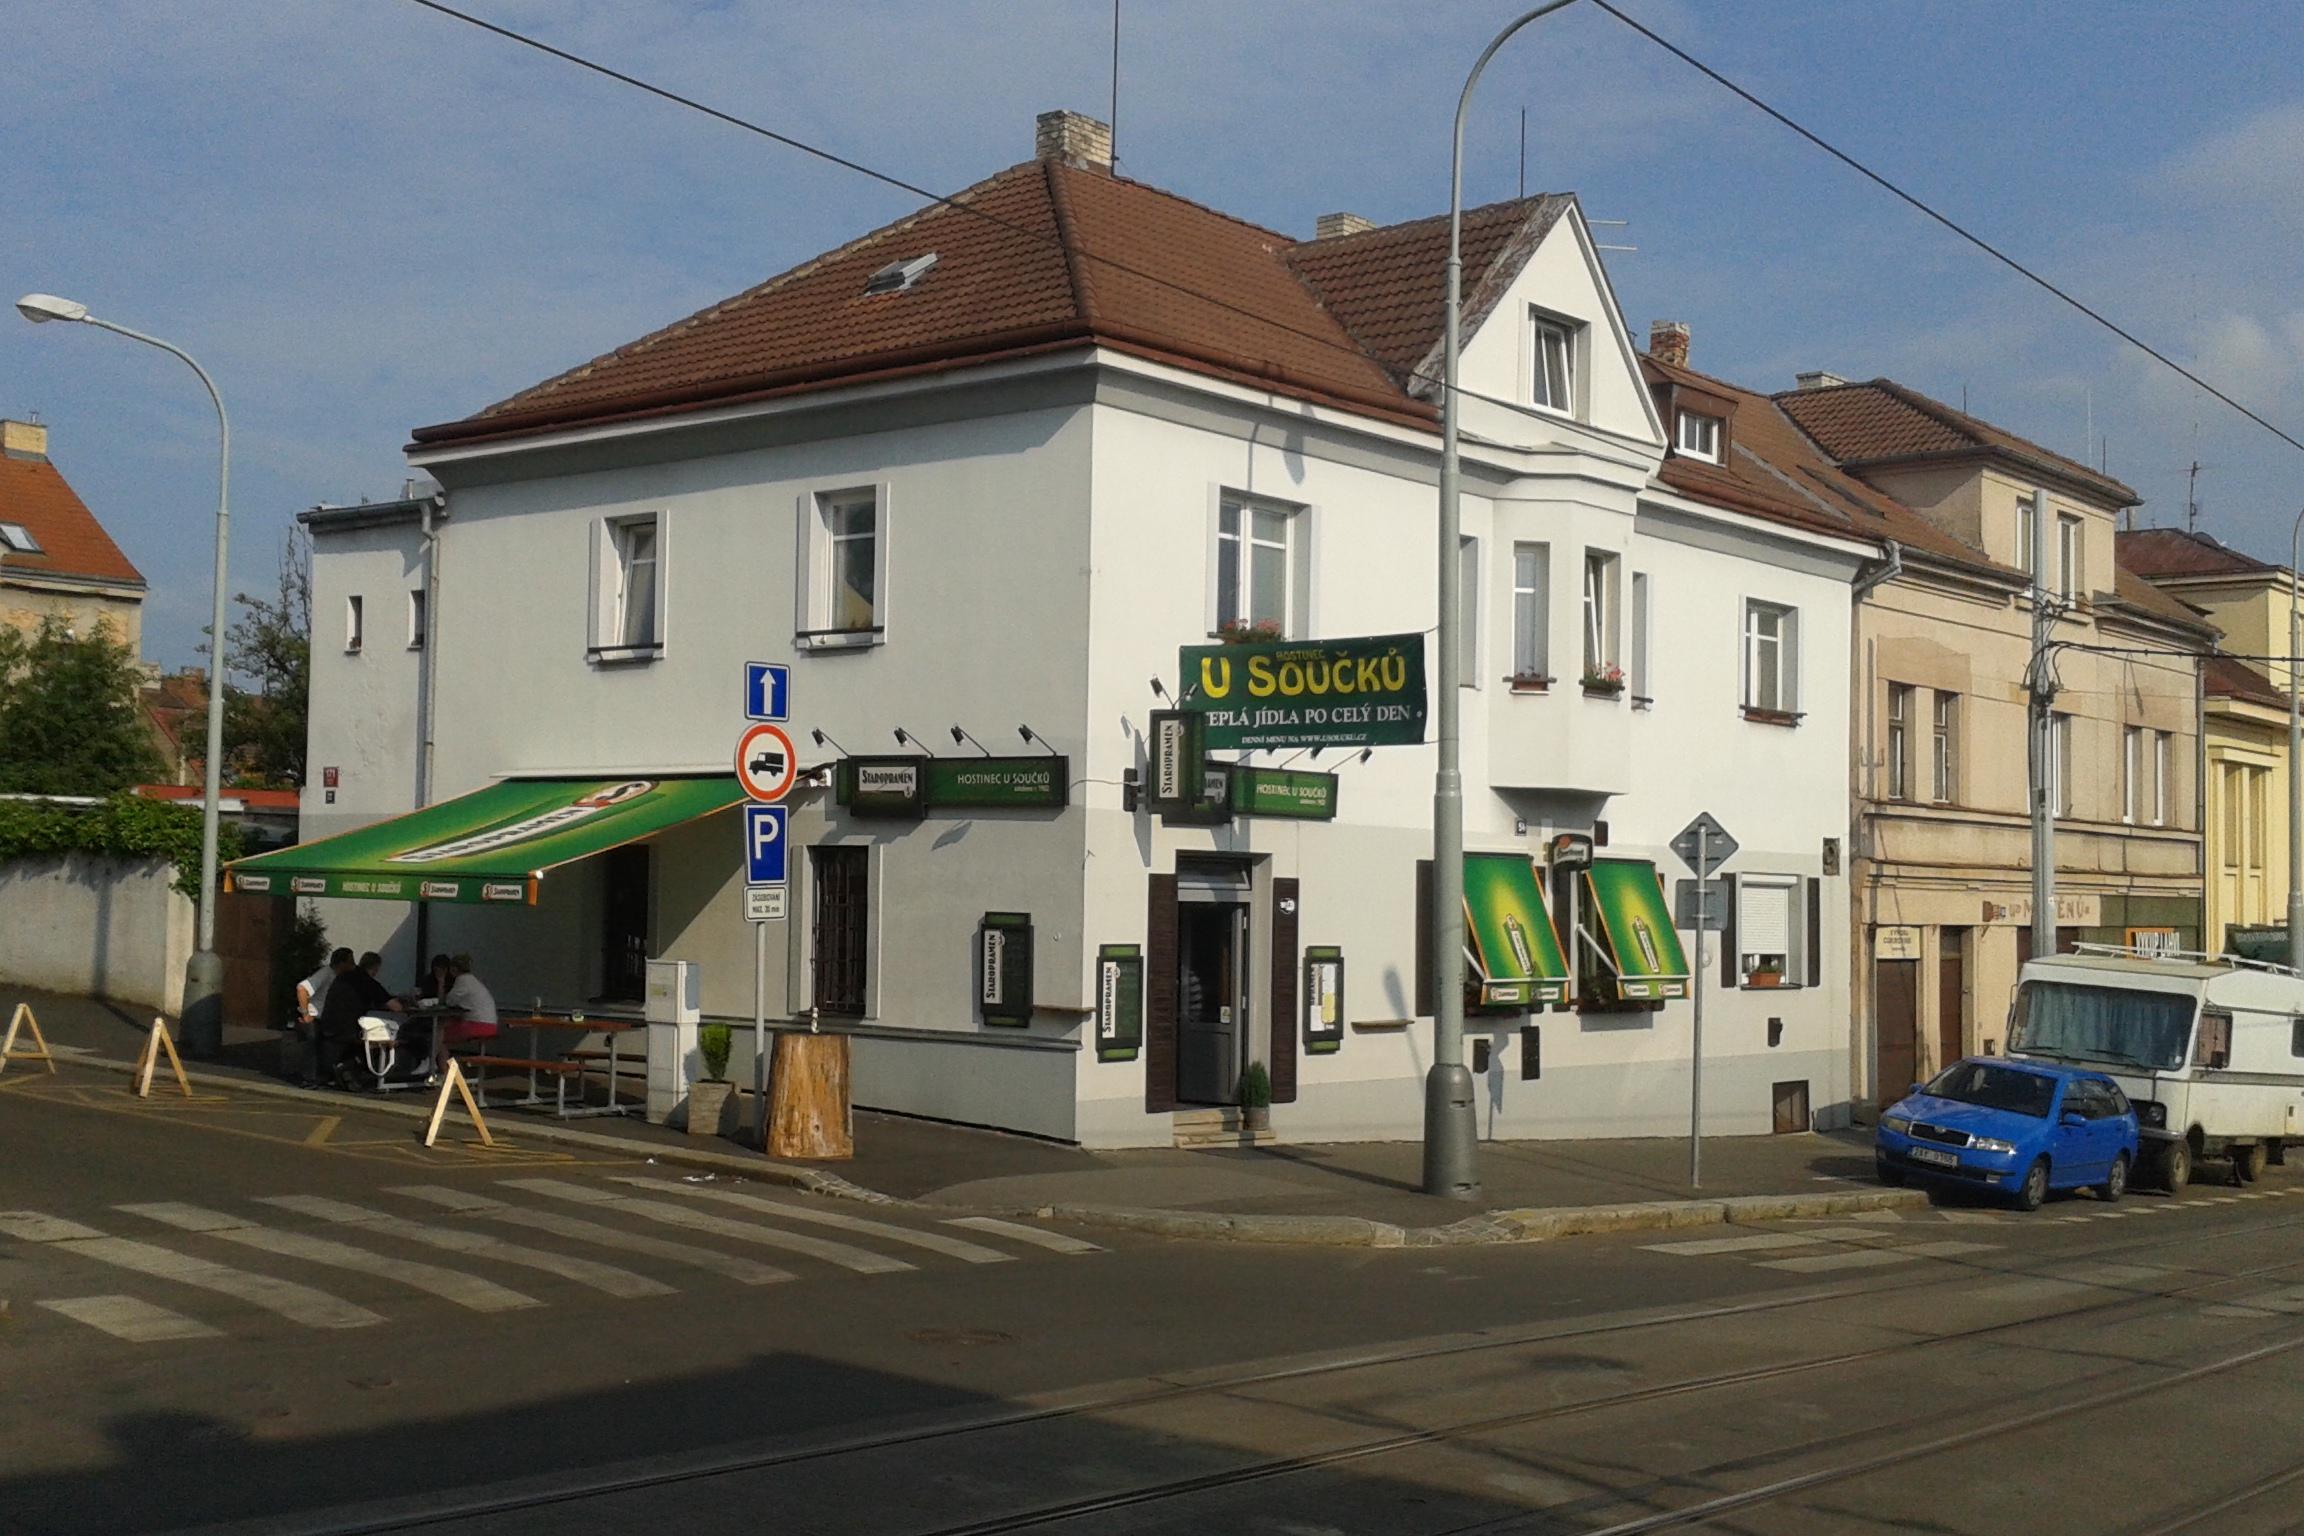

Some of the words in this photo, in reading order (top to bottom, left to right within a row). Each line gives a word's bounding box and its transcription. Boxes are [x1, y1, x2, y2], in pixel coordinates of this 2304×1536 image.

[1202, 657, 1231, 698] U
[1253, 706, 1299, 728] JÍDLA
[1305, 708, 1327, 724] PO
[1332, 702, 1371, 723] CELÝ
[1377, 704, 1411, 722] DEN
[957, 773, 1001, 784] HOSTINEC
[1003, 772, 1010, 783] U
[1012, 771, 1050, 784] SOUČKŮ
[1292, 785, 1299, 797] U
[754, 814, 779, 859] P
